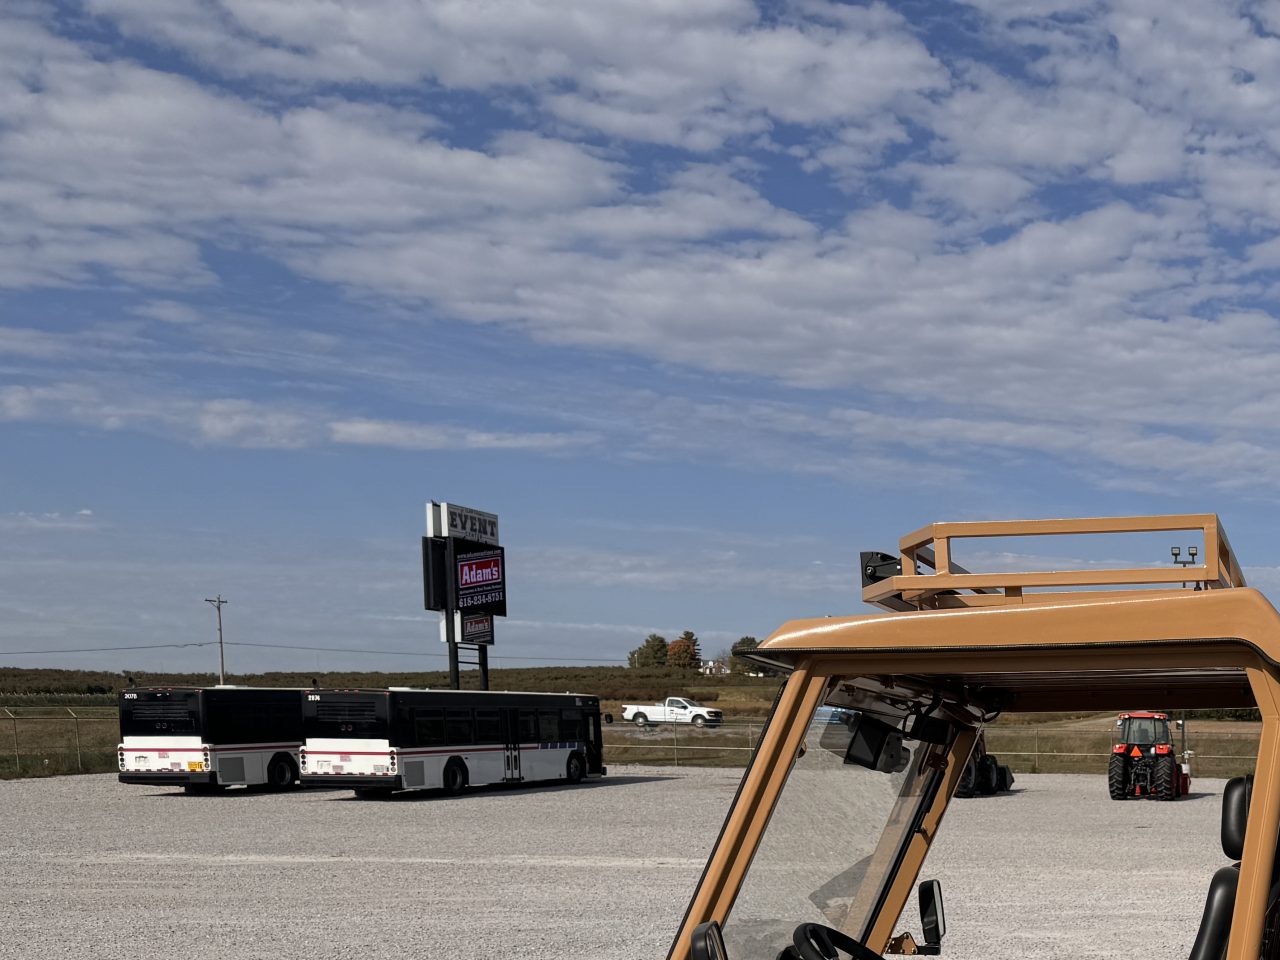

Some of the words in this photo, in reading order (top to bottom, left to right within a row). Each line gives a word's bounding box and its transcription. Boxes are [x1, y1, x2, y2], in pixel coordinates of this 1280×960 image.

[450, 511, 497, 537] EVENT
[461, 561, 498, 585] Adam's
[459, 592, 503, 607] 618-234-8751
